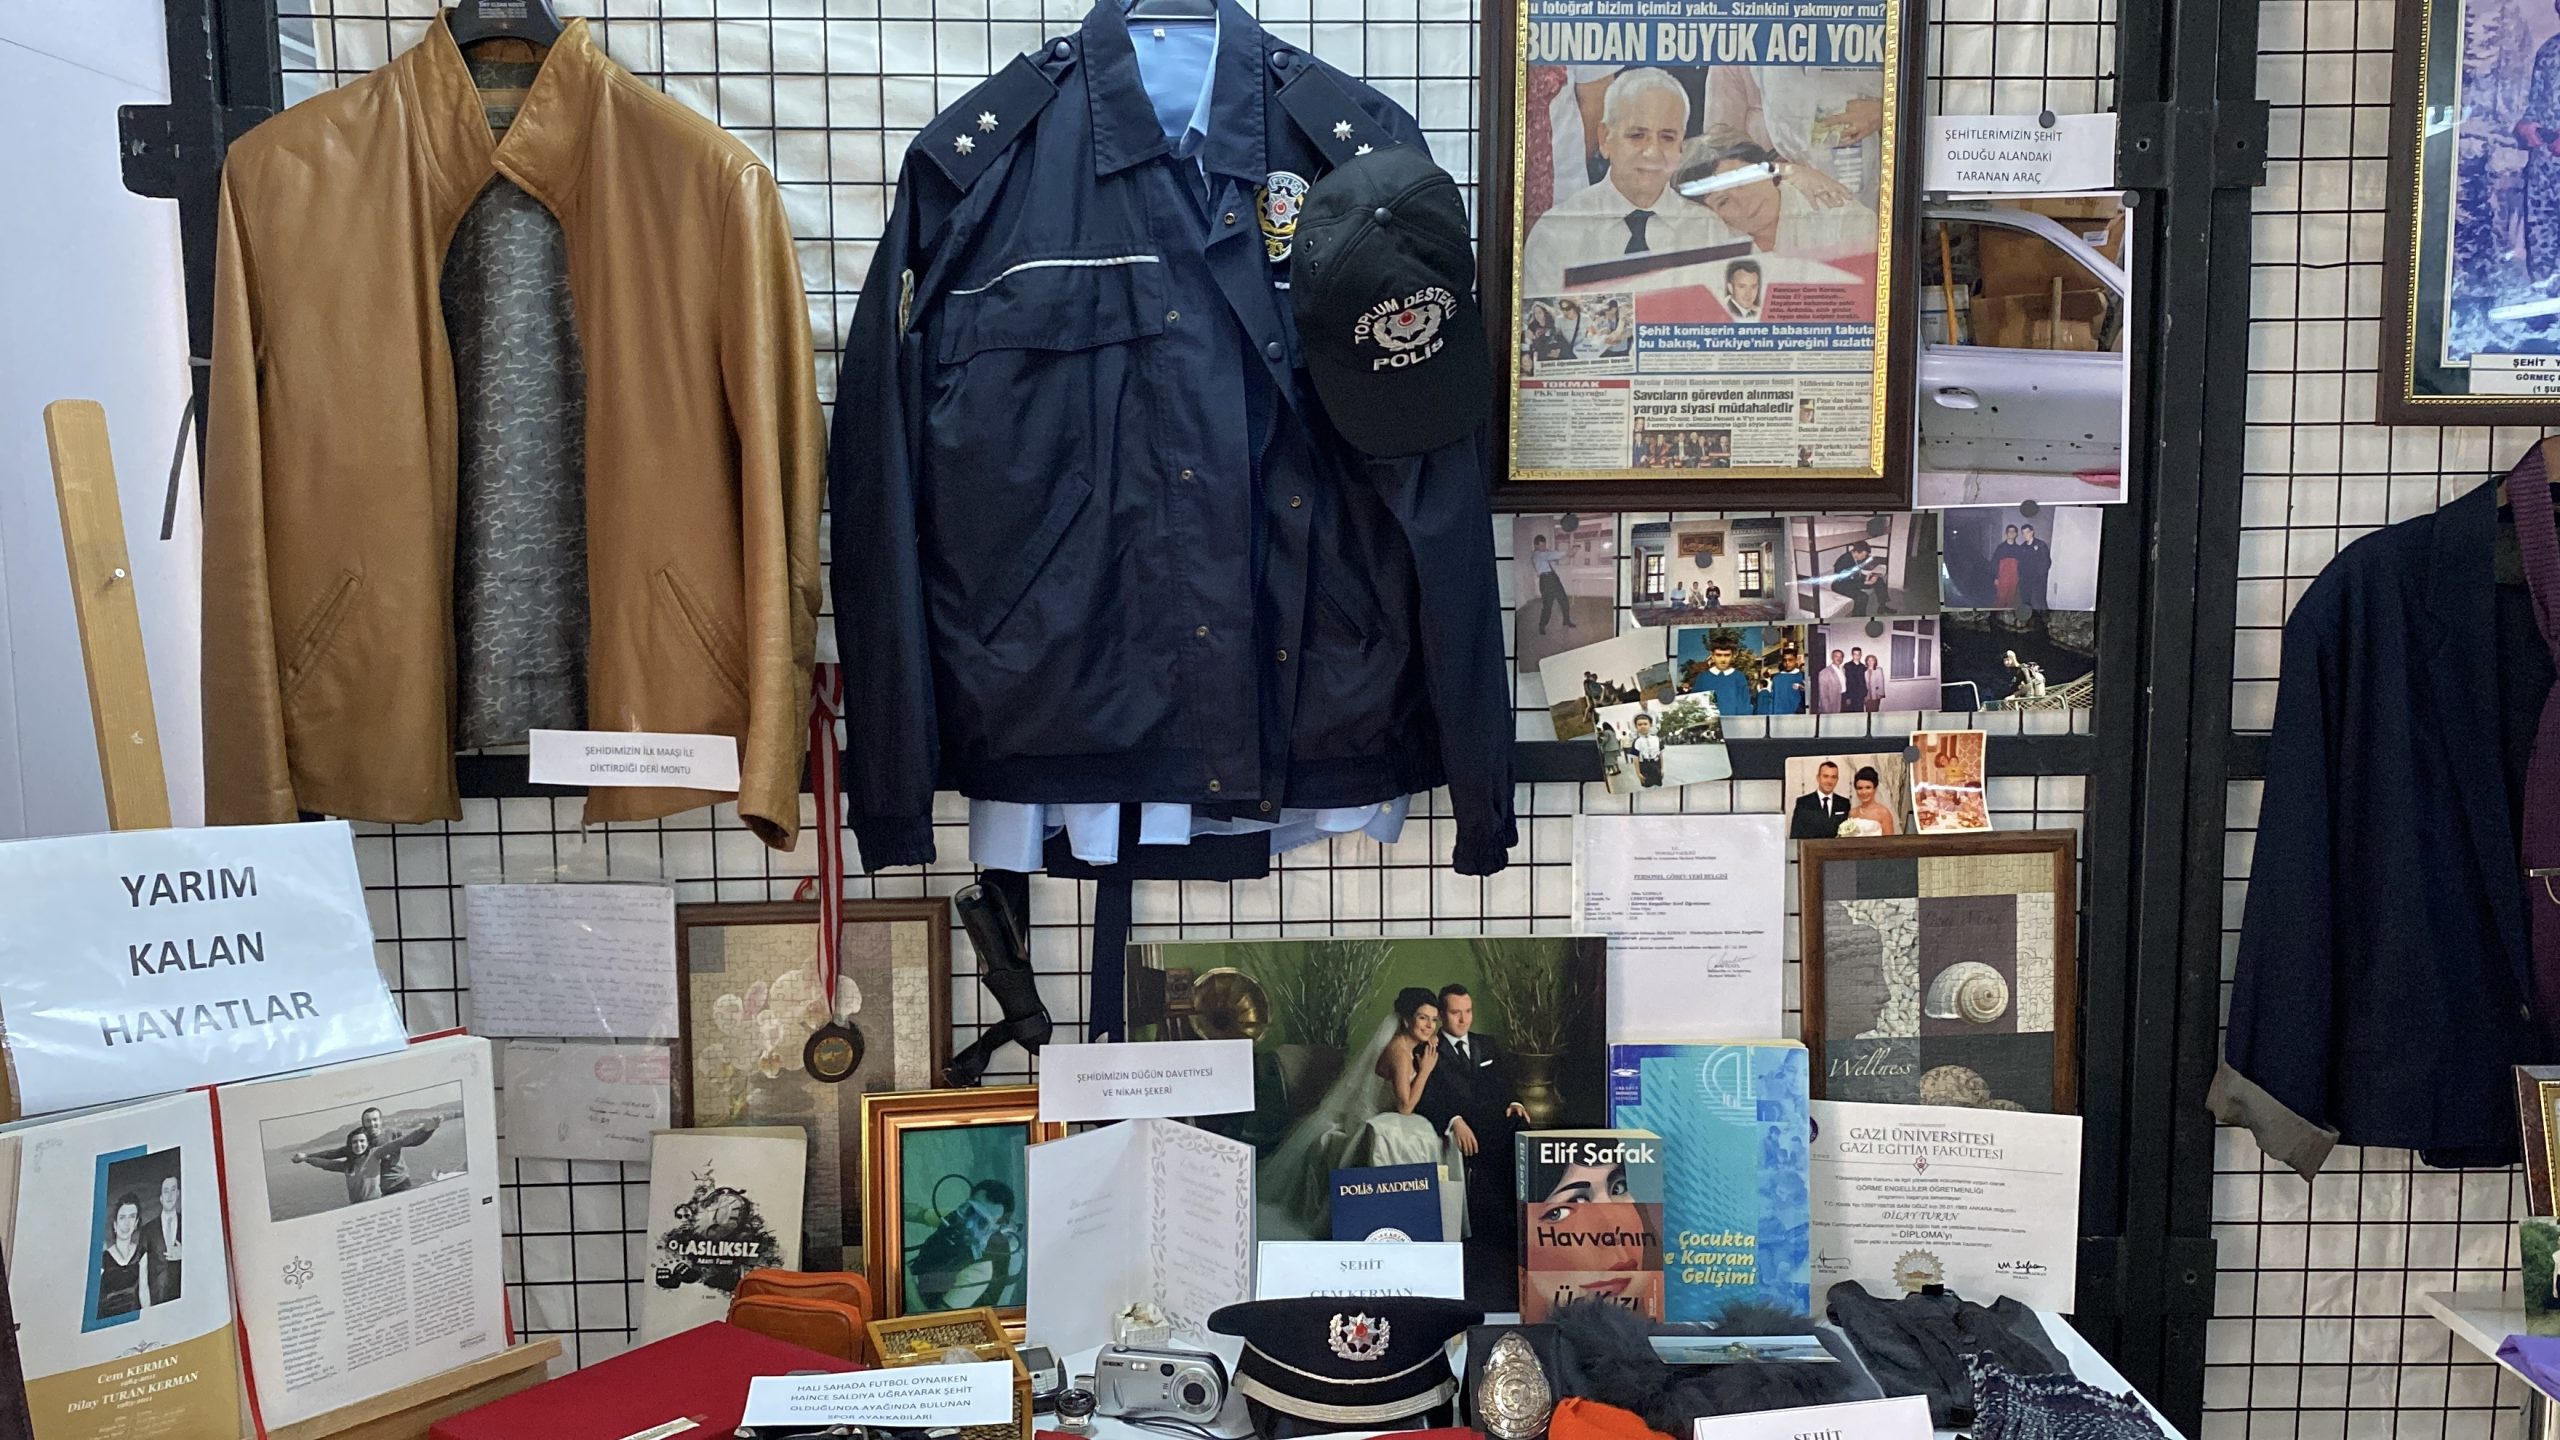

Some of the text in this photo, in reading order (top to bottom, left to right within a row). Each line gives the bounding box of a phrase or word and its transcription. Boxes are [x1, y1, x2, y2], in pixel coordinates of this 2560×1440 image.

[1529, 3, 1539, 15] u
[1543, 1, 1593, 16] fotoğraf
[1597, 1, 1633, 15] bizim
[1638, 1, 1682, 16] içimizi
[1731, 3, 1789, 17] Sizinkini
[1793, 4, 1854, 18] yakmıyor
[1858, 4, 1886, 17] mu?
[1528, 22, 1886, 63] BUNDAN BÜYÜK ACI YOK
[1945, 127, 2063, 143] ŞEHİTLERİMİZİN ŞEHİT
[1947, 149, 1996, 161] OLDUĞU
[1957, 171, 2042, 184] TARANAN ARAÇ
[1354, 298, 1400, 345] TOPLUM
[1638, 325, 1875, 338] Şehit komiserin anne babasının tabuta
[1638, 338, 1654, 348] bu
[1658, 338, 1700, 350] bakışı,
[1704, 338, 1774, 350] Türkiye'nin
[1777, 337, 1828, 350] yüreğini
[2513, 357, 2546, 368] ŞEHİT
[2516, 374, 2556, 382] GÖRMEÇ
[1633, 389, 1688, 401] Savcıların
[1691, 389, 1743, 401] görevden
[1746, 389, 1794, 401] alınması
[1633, 402, 1794, 415] yargıya siyasi müdahaledir
[585, 745, 694, 759] ŞEHİDİMİZİN İLK MAAŞI İLE
[590, 762, 691, 775] DİKTİRDİĞİ DERİ MONTU
[120, 865, 258, 908] YARIM
[129, 931, 265, 977] KALAN
[100, 991, 320, 1046] HAYATLAR
[1829, 1047, 1912, 1078] Wellness
[1076, 1067, 1213, 1083] ŞEHİDİMİZİN DÜĞÜN DAVETİYESİ
[1102, 1086, 1172, 1097] VE NİKAH ŞEKERİ
[1850, 1127, 1995, 1146] GAZİ ÜNİVERSİTESİ
[1540, 1143, 1656, 1166] Elif Şafak
[1839, 1142, 2004, 1160] GAZİ EĞİTİM FAKÜLTESİ
[1339, 1177, 1429, 1197] POLİS AKADEMİSİ
[1856, 1184, 1883, 1192] GÖRME
[1881, 1211, 1960, 1221] DİLAY TURAN
[1537, 1226, 1658, 1247] Havva'nın
[1678, 1229, 1756, 1250] Çocukta
[1899, 1230, 1952, 1240] DİPLOMA'yı
[668, 1239, 760, 1258] OLASILIKSIZ
[1339, 1258, 1384, 1272] ŞEHİT
[1664, 1249, 1755, 1266] e Kavram
[1681, 1265, 1757, 1288] Gelişimi
[1310, 1287, 1414, 1297] CEM KERMAN
[97, 1355, 179, 1384] Cem KERMAN
[797, 1375, 968, 1392] HALI SAHADA FUTBOL OYNARKEN
[67, 1371, 200, 1414] Dilay TURAN KERMAN
[832, 1391, 875, 1401] SALDIYA
[878, 1388, 942, 1399] UĞRAYARAK
[943, 1385, 973, 1396] ŞEHİT
[790, 1400, 972, 1412] OLDUĞUNDA AYAĞINDA BULUNAN
